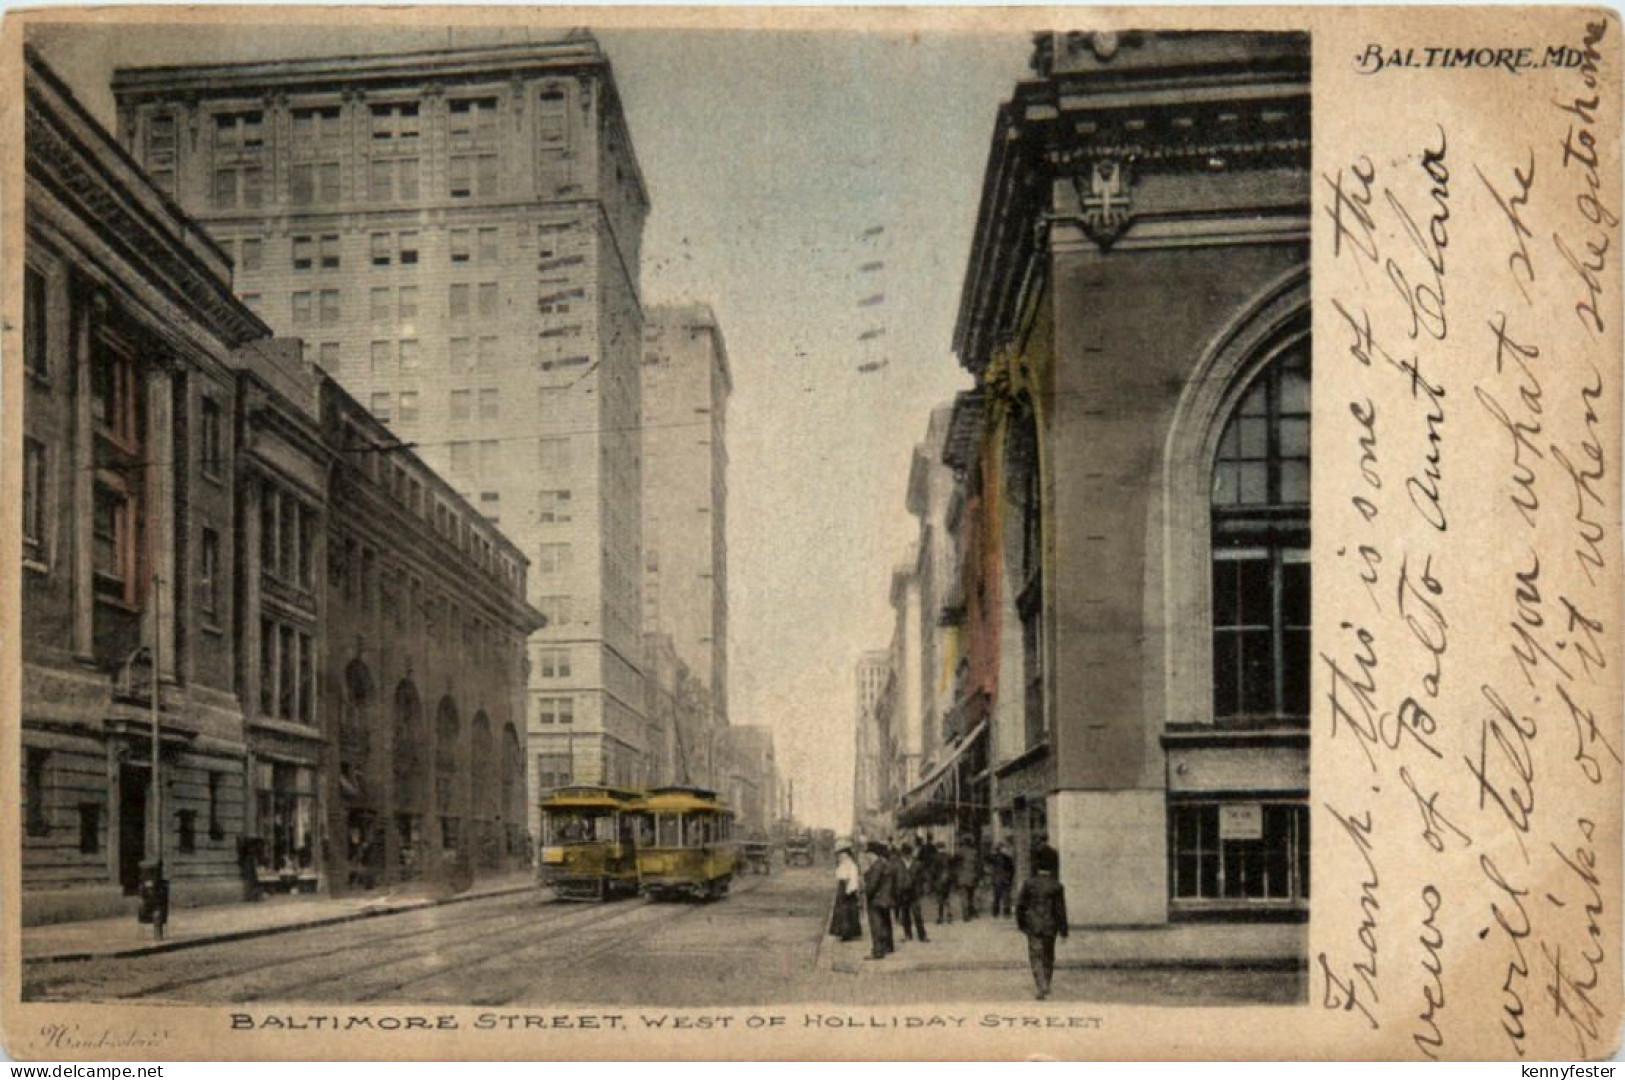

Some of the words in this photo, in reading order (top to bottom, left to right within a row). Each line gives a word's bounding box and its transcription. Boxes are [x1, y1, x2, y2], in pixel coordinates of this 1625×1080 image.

[1323, 154, 1378, 290] the
[1474, 147, 1534, 305] she
[1553, 232, 1609, 340] she
[1332, 298, 1398, 368] of
[1474, 310, 1544, 528] what
[1550, 363, 1604, 588] when
[1556, 683, 1622, 784] of
[1400, 766, 1472, 852] of
[1478, 854, 1531, 1056] will
[1541, 818, 1604, 1060] thinks
[229, 1013, 459, 1030] BALTIMORE
[641, 1015, 734, 1029] WEST
[746, 1015, 787, 1028] OF
[804, 1015, 965, 1029] HOLLIDAY
[980, 1015, 1103, 1028] STREET
